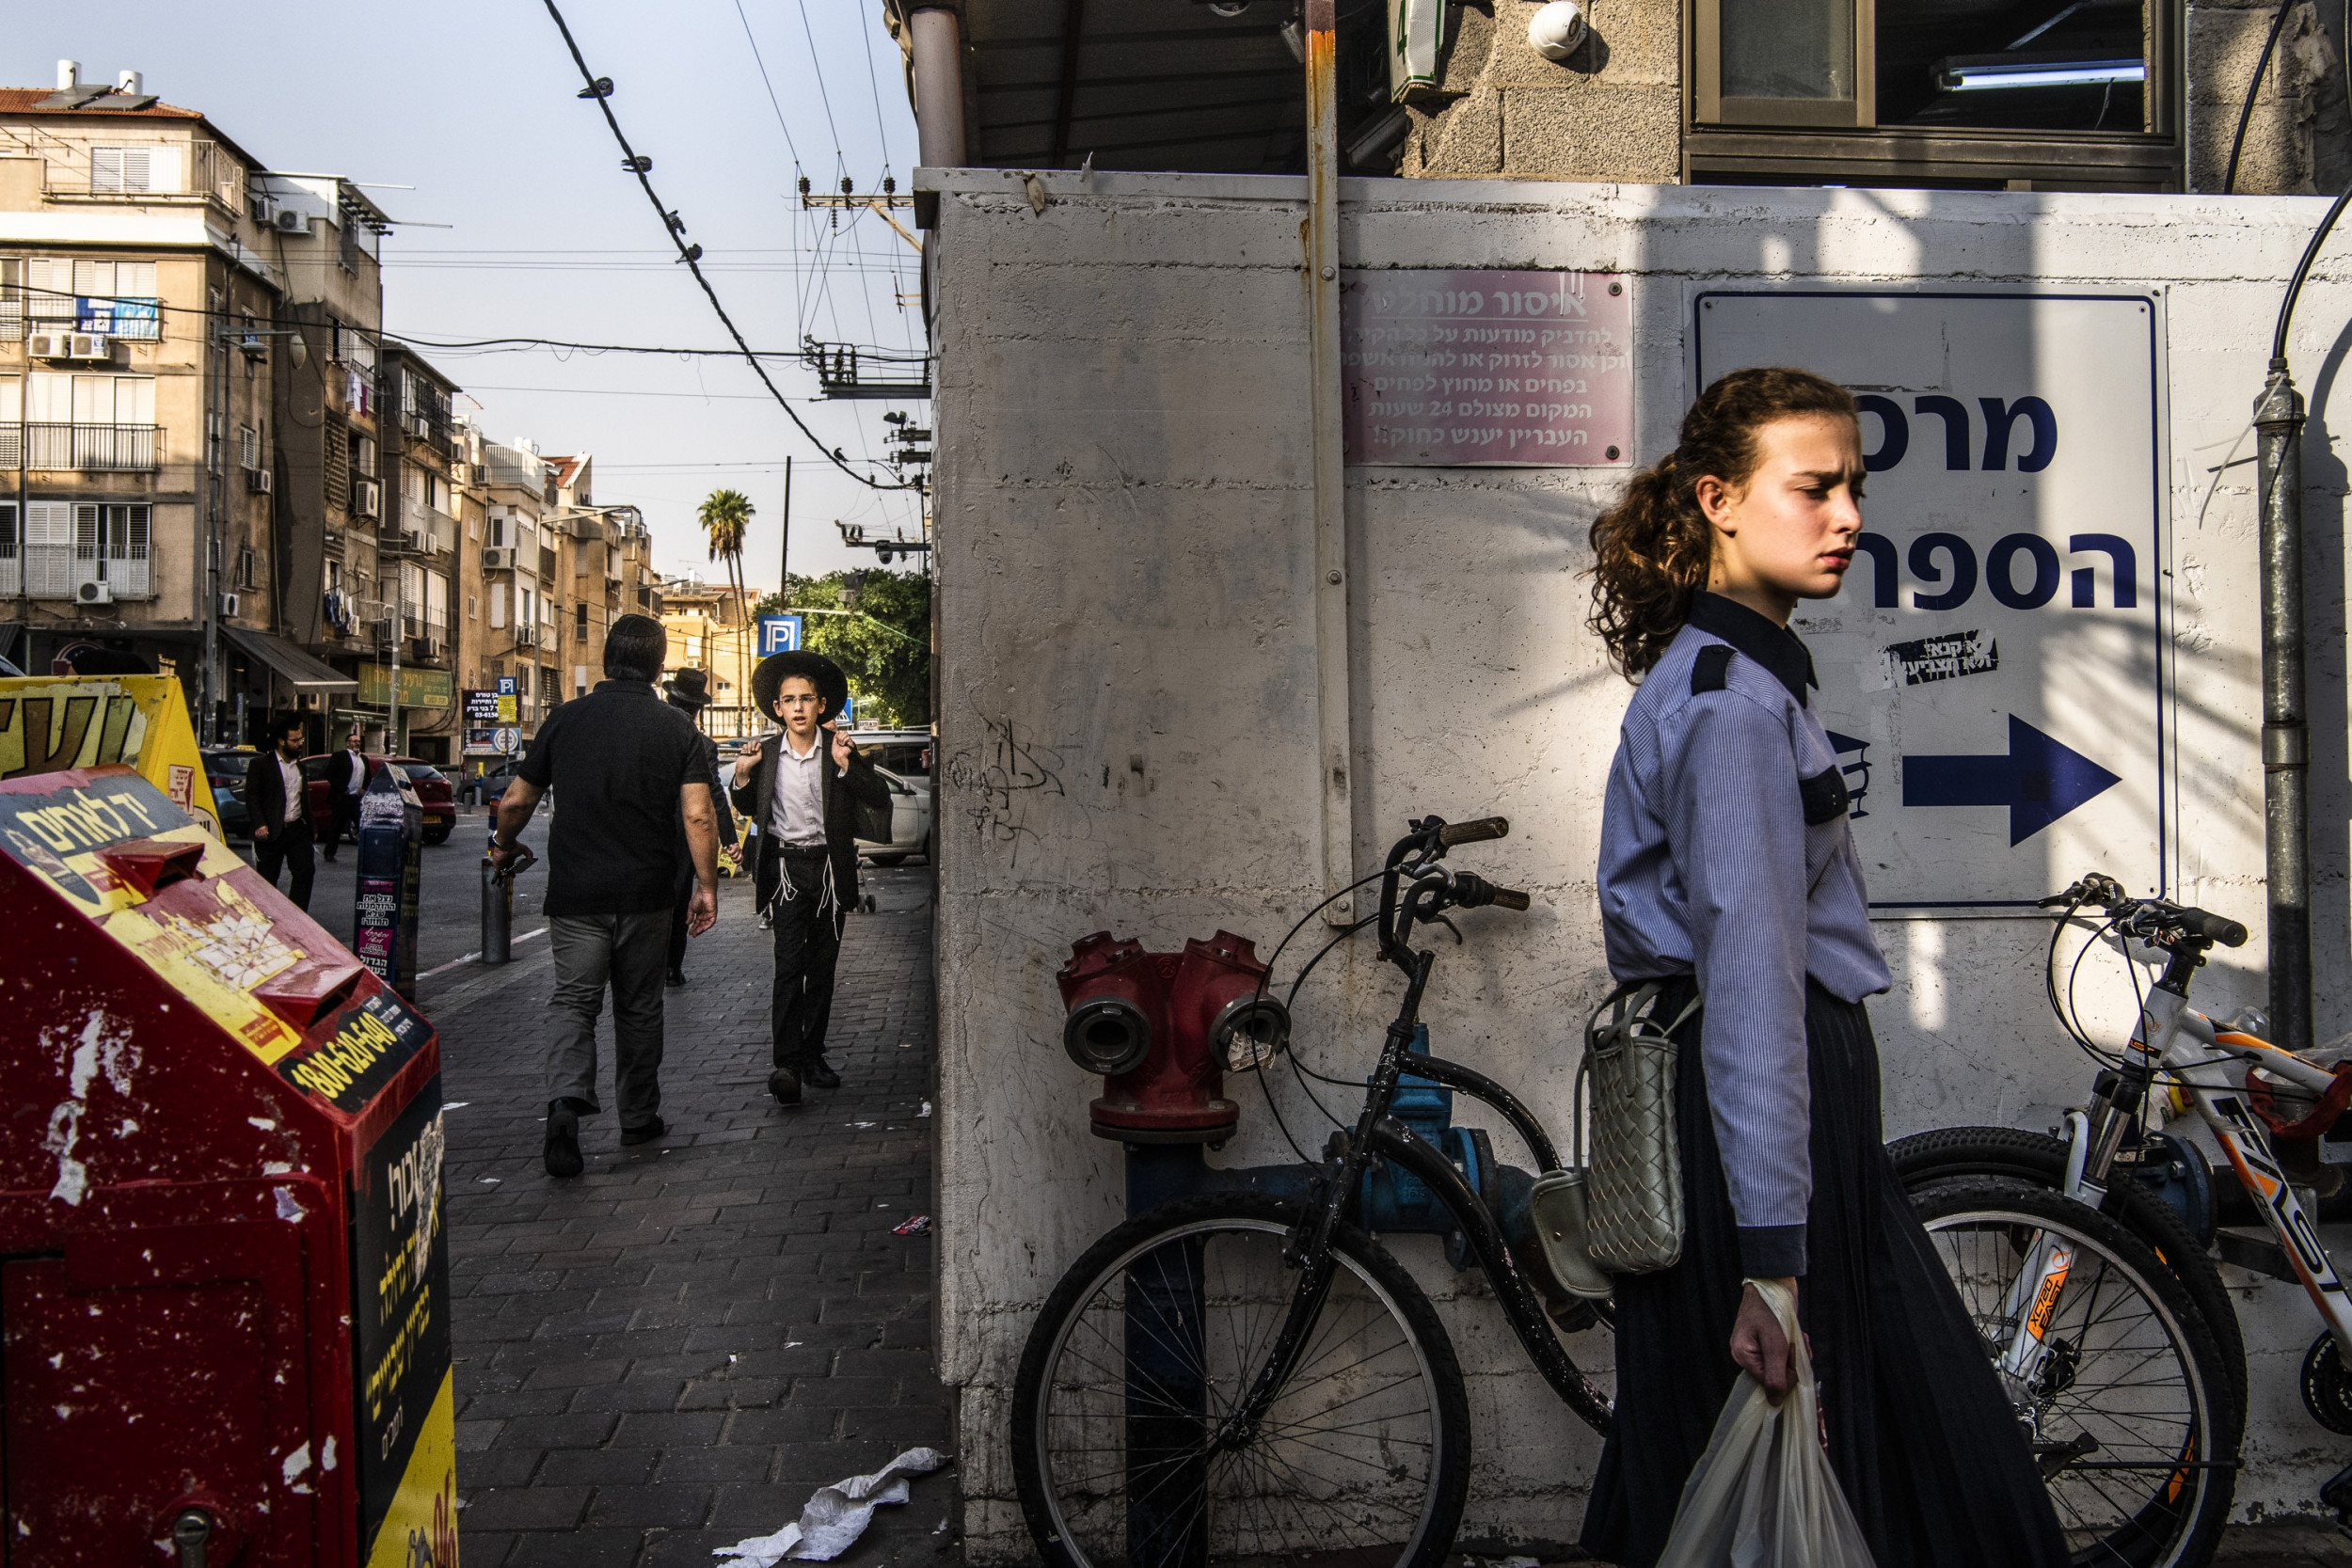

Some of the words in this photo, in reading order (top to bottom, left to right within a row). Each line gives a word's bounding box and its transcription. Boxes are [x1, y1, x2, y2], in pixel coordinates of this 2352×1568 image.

[1492, 290, 1587, 317] איסור
[1434, 324, 1458, 344] על
[1463, 328, 1536, 345] מודעות
[1541, 326, 1613, 348] להדביק
[1462, 352, 1485, 368] או
[1489, 349, 1543, 372] לזרוק
[1551, 353, 1596, 371] אסור
[1374, 372, 1438, 393] לפחים
[1441, 376, 1494, 396] מחוץ
[1498, 377, 1520, 393] או
[1525, 377, 1588, 394] בפחים
[1368, 400, 1424, 419] שעות
[1429, 400, 1454, 417] 24
[1458, 399, 1521, 420] מצולם
[1525, 402, 1593, 423] המקום
[1450, 427, 1503, 448] יענש
[1508, 427, 1589, 450] העבריין
[1855, 394, 2058, 473] מרכ
[1855, 531, 2137, 610] הספר
[15, 788, 132, 853] לאחים
[107, 792, 158, 831] יד
[362, 894, 376, 903] את
[366, 909, 386, 919] שלא
[359, 954, 388, 967] הגדול
[2030, 1277, 2053, 1327] XC720
